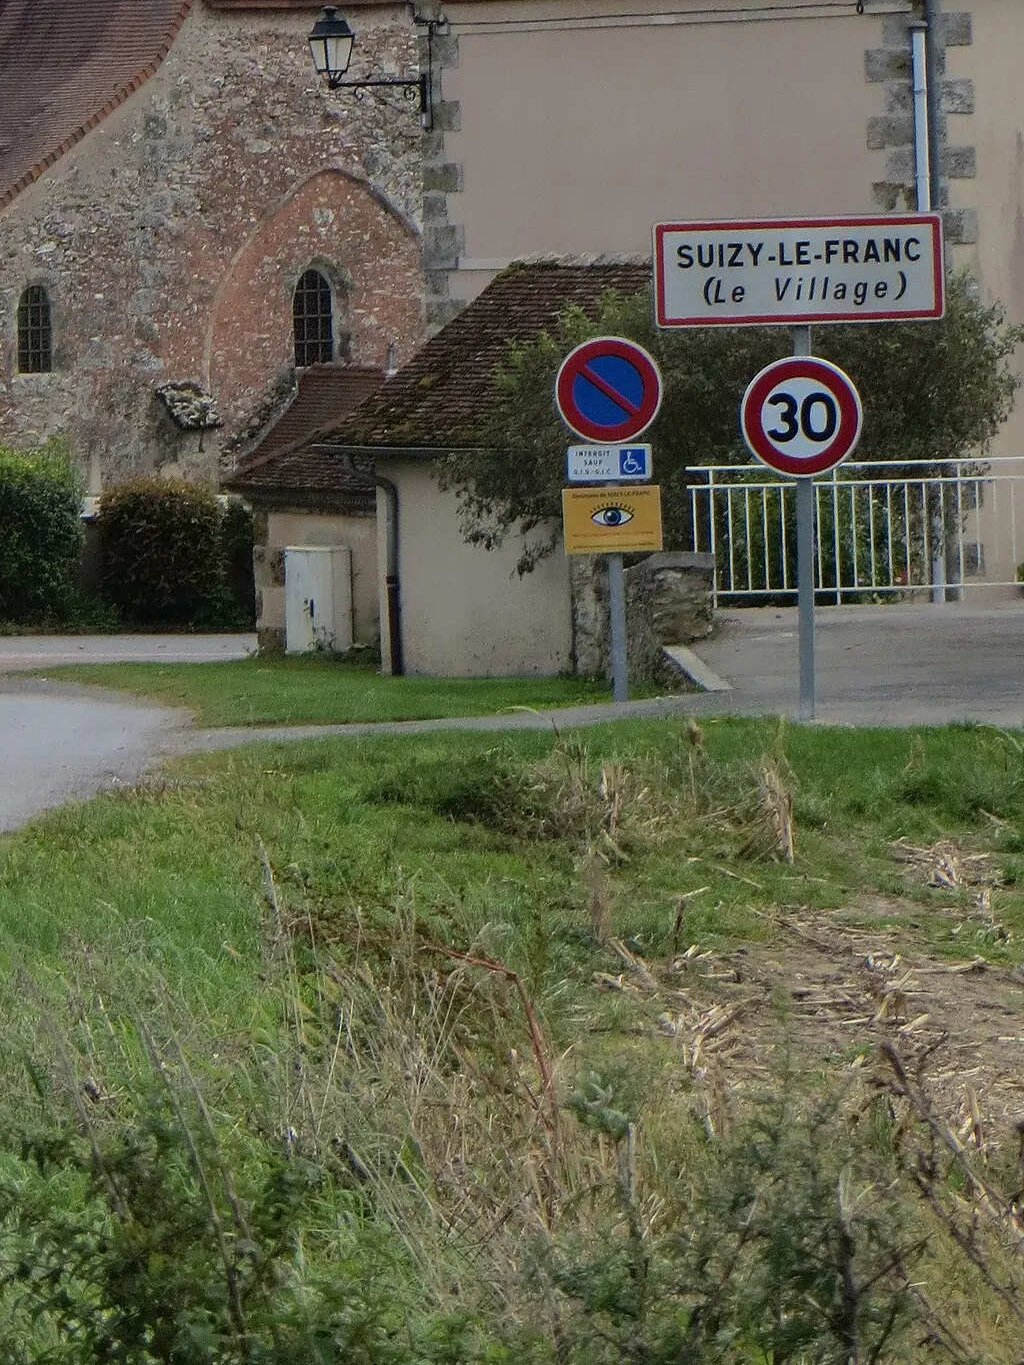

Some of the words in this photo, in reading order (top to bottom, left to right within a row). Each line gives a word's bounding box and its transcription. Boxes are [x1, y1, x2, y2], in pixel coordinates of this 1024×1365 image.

[676, 237, 921, 269] SUIZY-LE-FRANC
[703, 276, 746, 306] (Le
[774, 271, 907, 306] Village)
[766, 392, 837, 443] 30
